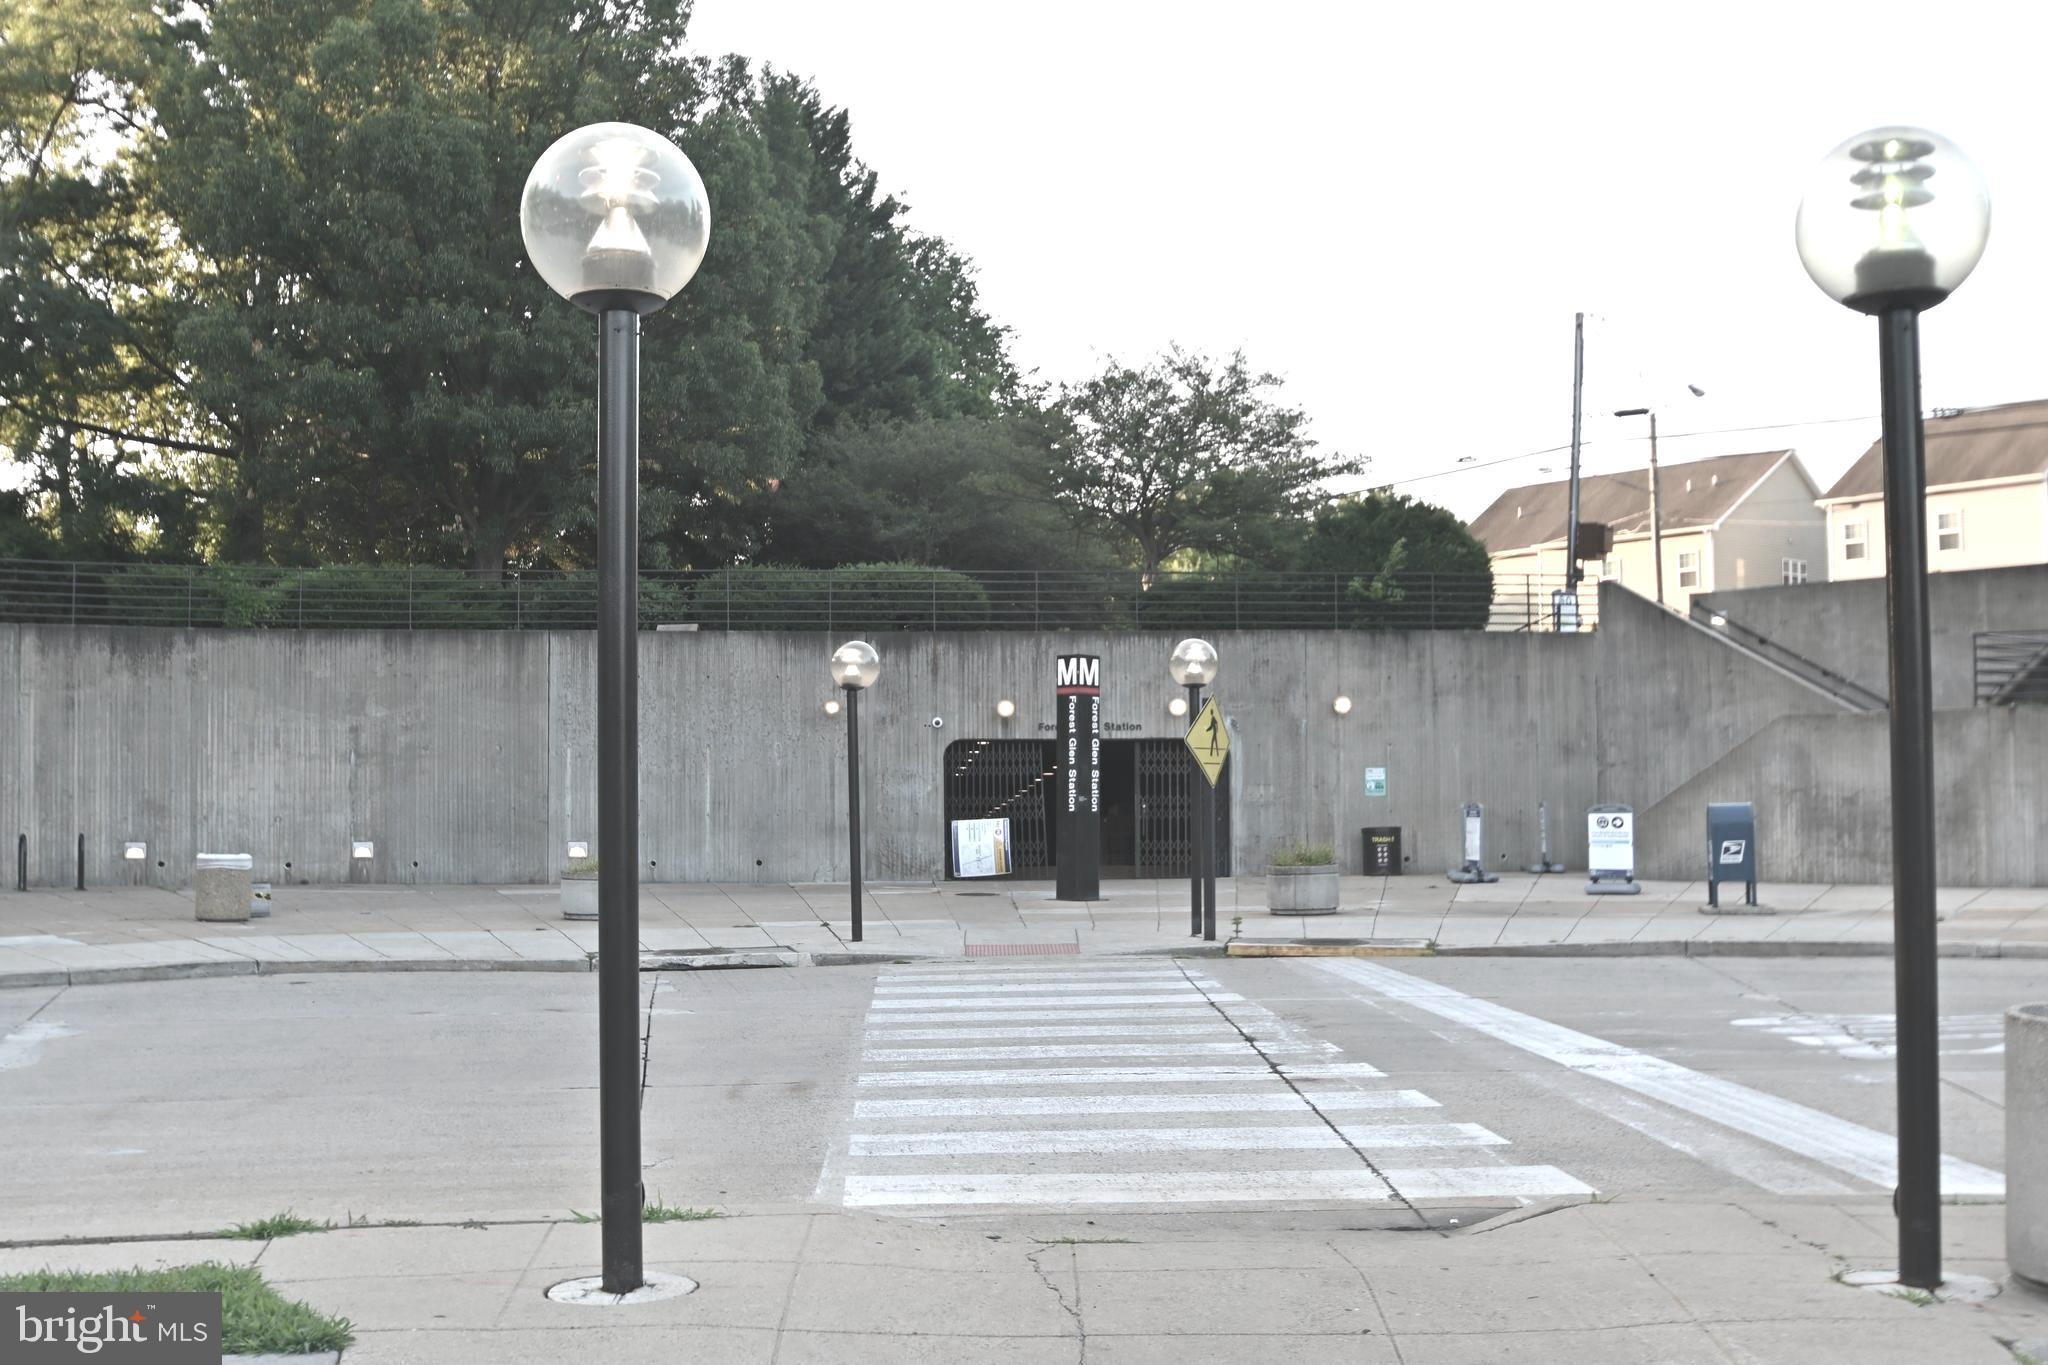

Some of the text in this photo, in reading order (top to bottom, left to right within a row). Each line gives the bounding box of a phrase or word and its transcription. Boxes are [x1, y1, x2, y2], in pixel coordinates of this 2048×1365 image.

[1069, 695, 1077, 812] Forest Glen Station
[1104, 722, 1142, 732] Station
